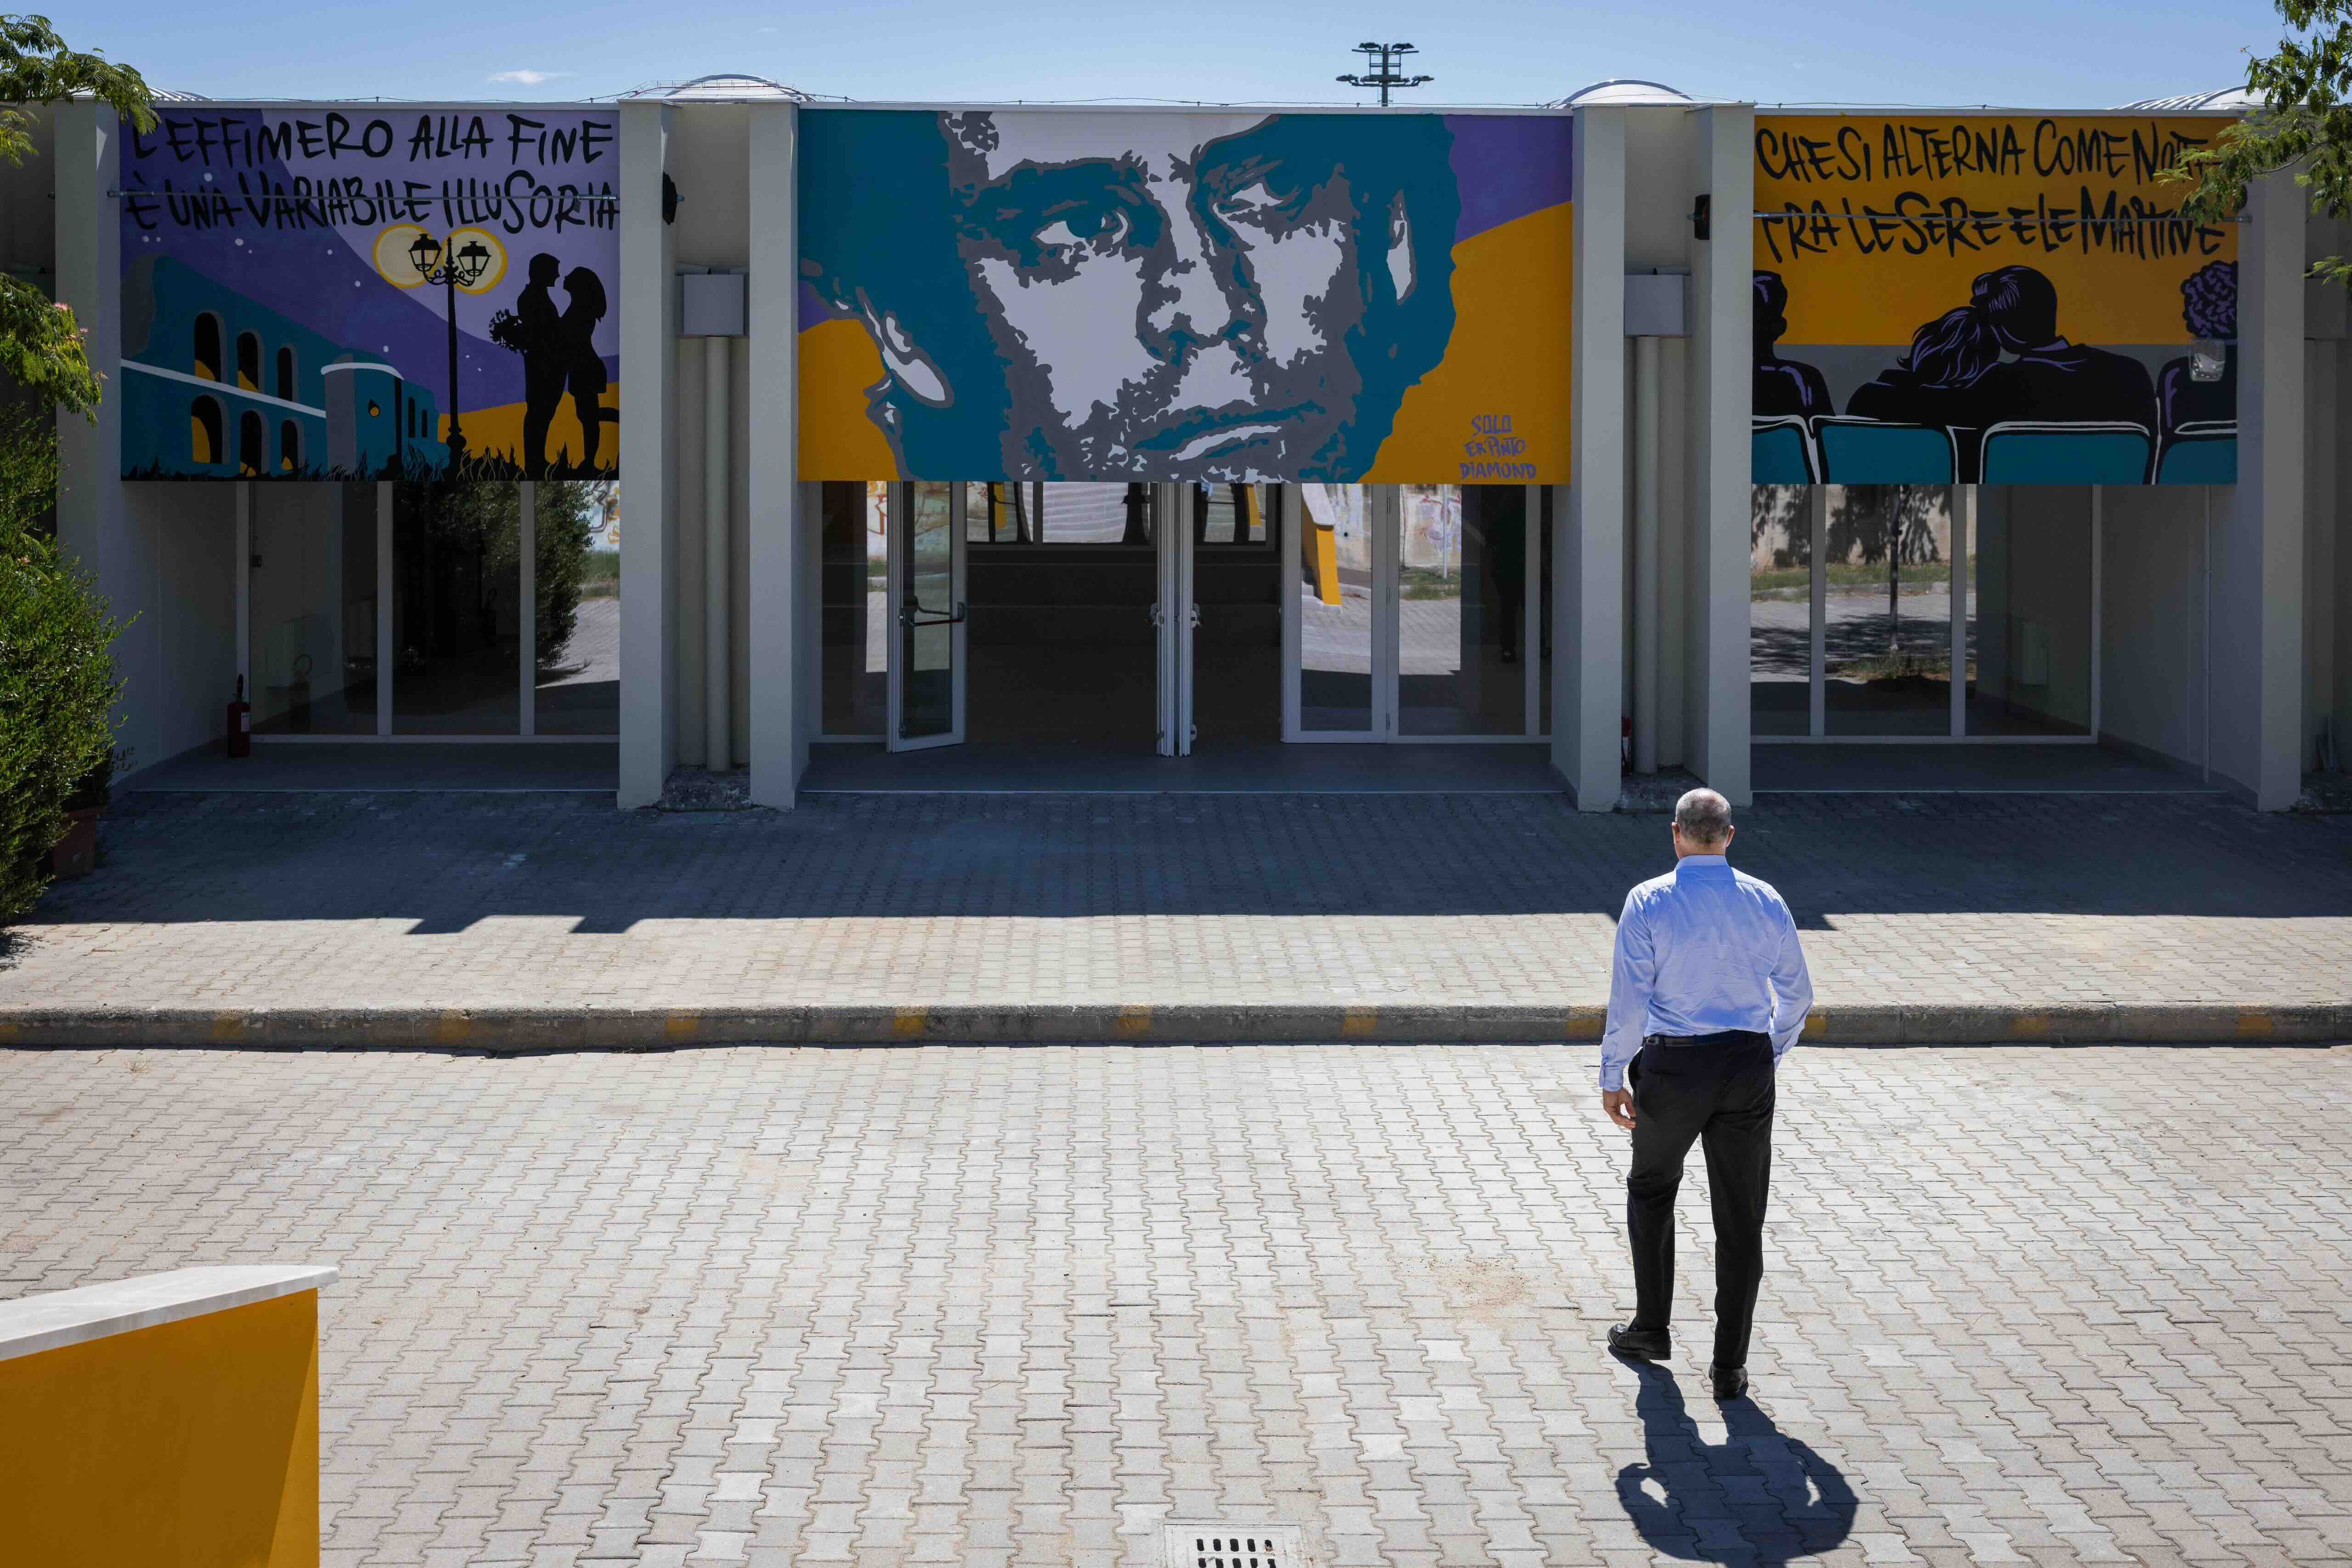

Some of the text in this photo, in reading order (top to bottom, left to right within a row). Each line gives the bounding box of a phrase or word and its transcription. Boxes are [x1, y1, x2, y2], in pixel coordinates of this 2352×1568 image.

[132, 112, 613, 168] LEFFIMERO ALLA FINE
[1755, 119, 2228, 186] CHE SI ALTERNA COME NOTT
[164, 178, 243, 229] UNA
[238, 169, 433, 230] VARIABILE
[442, 169, 620, 234] ILLUSORIA
[1753, 185, 2226, 263] TRA LE SERE E LE MATTINE
[1470, 413, 1513, 438] SOLO
[1459, 462, 1537, 479] DIAMOND
